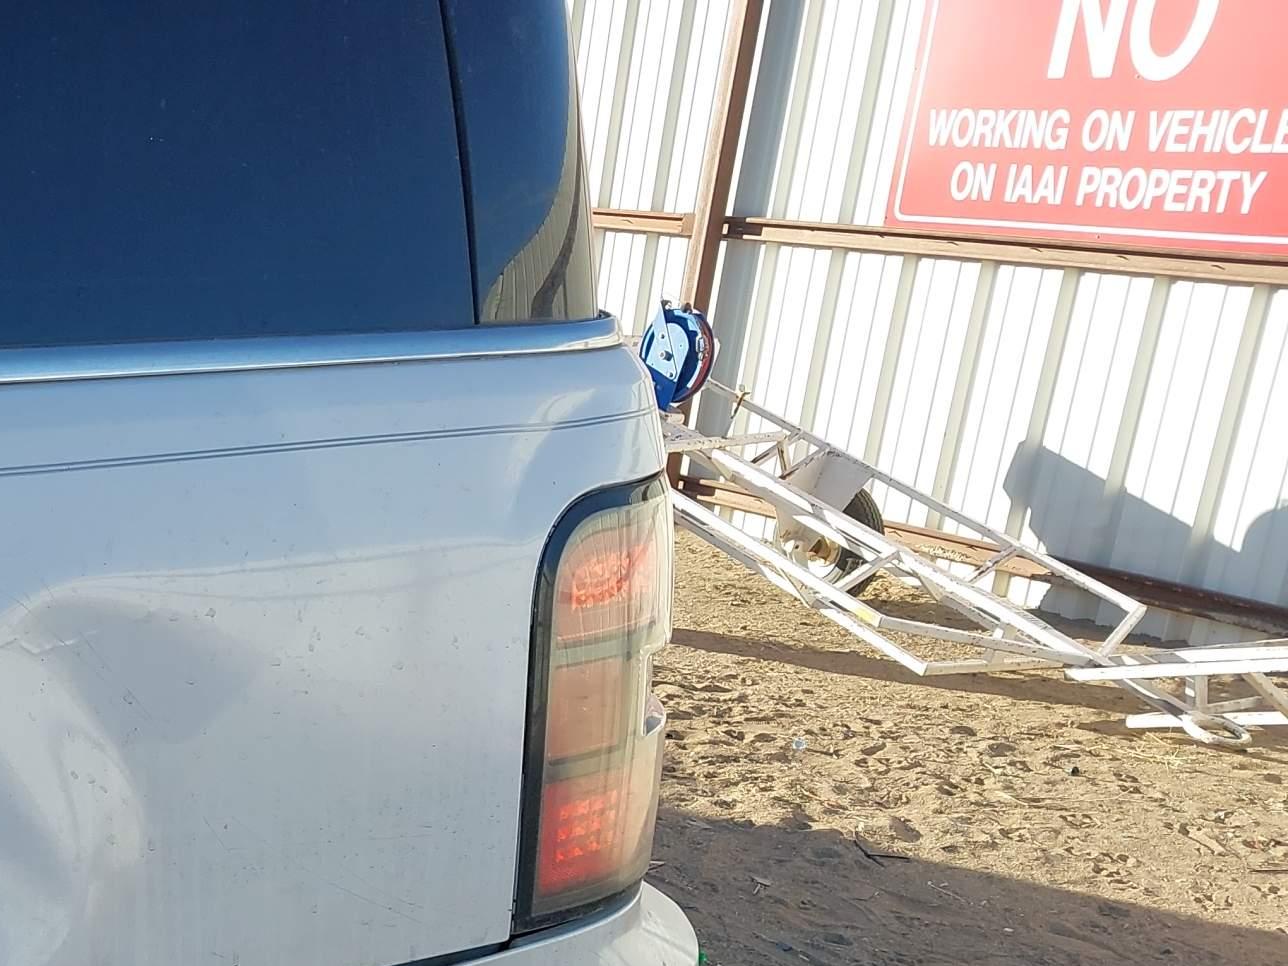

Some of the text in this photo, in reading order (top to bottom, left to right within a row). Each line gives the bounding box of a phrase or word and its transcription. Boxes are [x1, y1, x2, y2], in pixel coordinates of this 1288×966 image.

[1047, 0, 1220, 82] NO
[927, 107, 1071, 151] WORKING
[1080, 109, 1135, 152] ON
[949, 161, 1268, 215] ON IAAI PROPERTY
